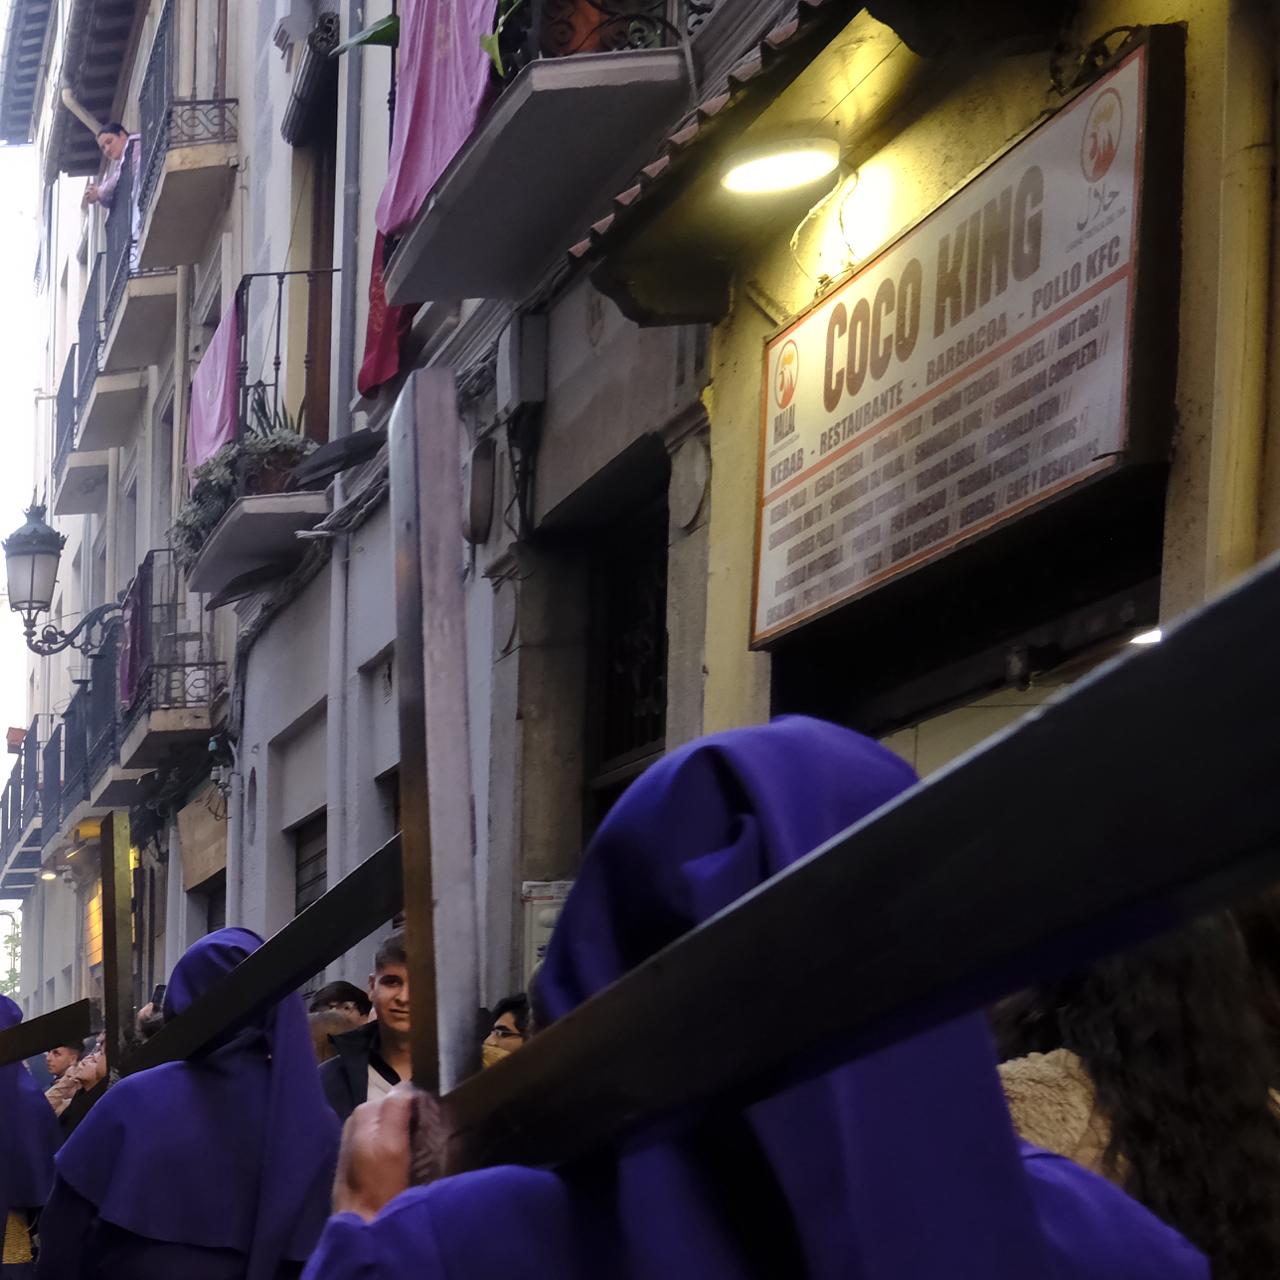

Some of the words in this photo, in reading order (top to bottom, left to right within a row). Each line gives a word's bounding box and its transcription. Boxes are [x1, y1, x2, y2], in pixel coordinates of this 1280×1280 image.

[770, 449, 803, 486] KEBAB
[820, 382, 903, 451] RESTAURANTE
[927, 315, 1006, 382] BARBACOA
[1032, 263, 1080, 316] POLLO
[1086, 237, 1119, 280] KFC
[824, 256, 923, 413] COCO
[934, 166, 1044, 338] KING
[1078, 305, 1098, 336] DOG
